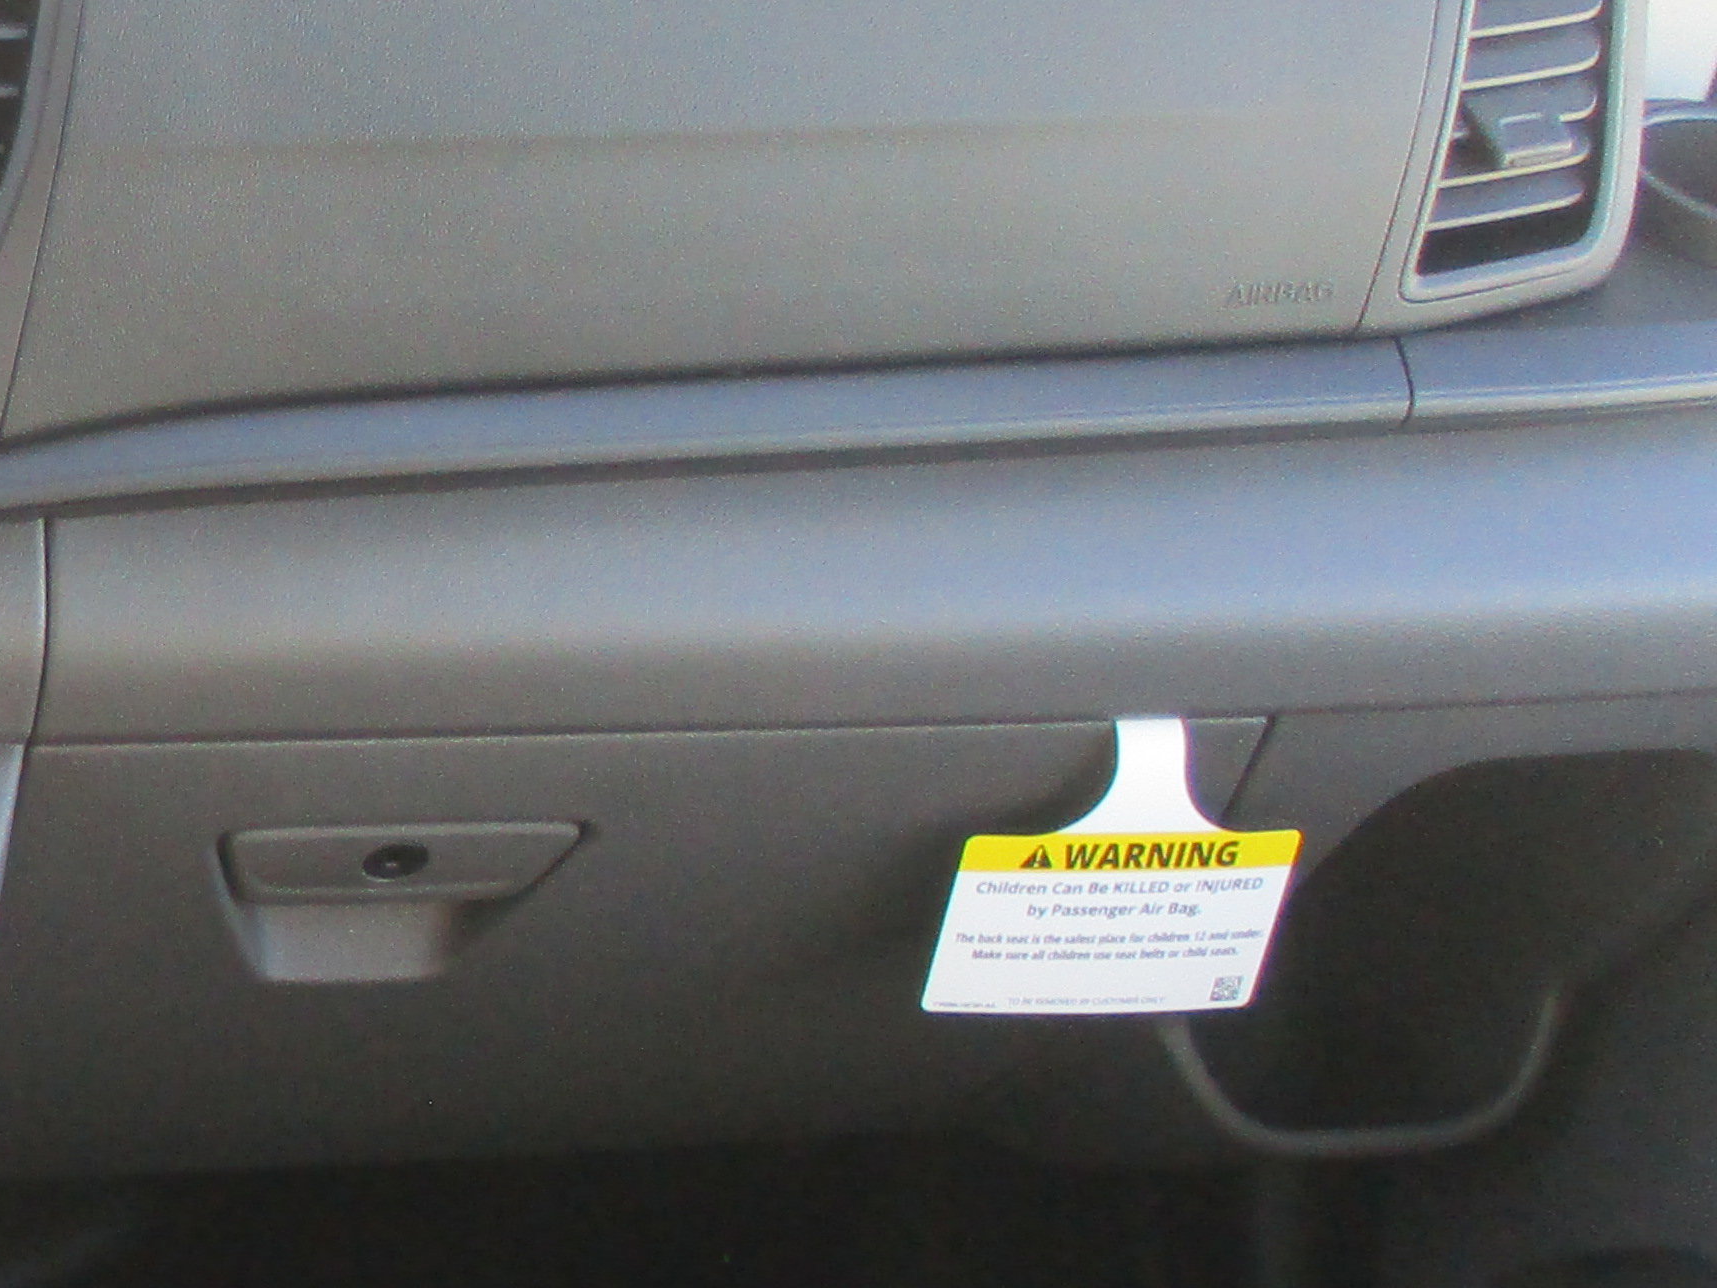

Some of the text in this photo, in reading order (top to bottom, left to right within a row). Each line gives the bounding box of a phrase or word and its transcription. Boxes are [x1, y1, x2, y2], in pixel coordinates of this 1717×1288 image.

[1225, 281, 1334, 308] AIRBAG
[1065, 841, 1240, 870] WARNING
[975, 877, 1264, 895] Children Can Be KILLED or INJURED
[1026, 901, 1202, 919] by Passenger Air Bag.
[955, 932, 975, 943] The
[977, 932, 1003, 943] back
[1005, 934, 1029, 944] seat
[1031, 933, 1040, 944] is
[1043, 933, 1062, 944] the
[1064, 933, 1096, 944] safest
[1098, 932, 1126, 946] place
[1129, 932, 1145, 943] for
[1147, 931, 1191, 943] children
[1208, 929, 1230, 941] and
[972, 949, 1002, 961] Make
[1005, 951, 1029, 961] sure
[1031, 949, 1046, 961] all
[1047, 949, 1091, 961] children
[1093, 951, 1112, 961] use
[1115, 950, 1138, 960] seat
[1139, 948, 1166, 960] belts
[1168, 950, 1180, 959] or
[1182, 947, 1208, 958] child
